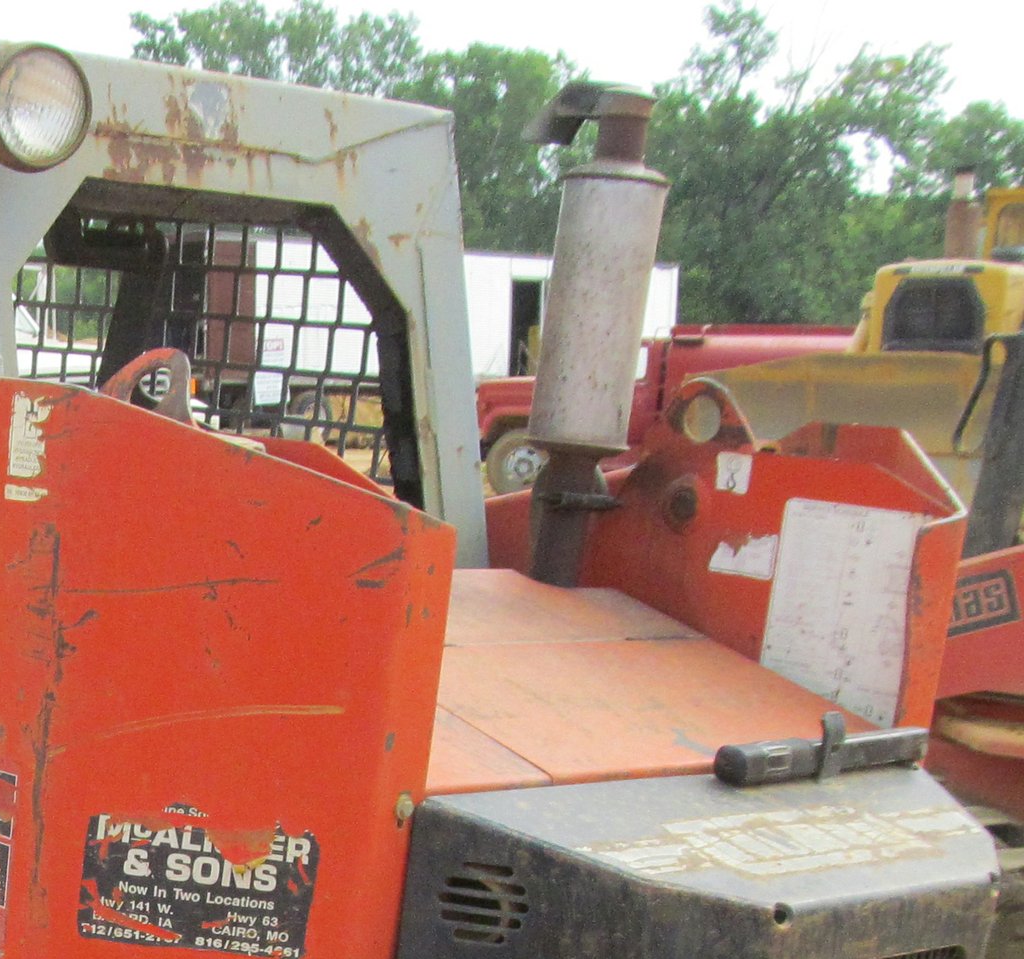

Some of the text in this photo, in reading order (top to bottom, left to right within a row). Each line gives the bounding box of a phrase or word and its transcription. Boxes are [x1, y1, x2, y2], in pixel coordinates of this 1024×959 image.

[123, 848, 277, 893] & SONS
[118, 881, 276, 911] Now In Two Locations
[129, 900, 151, 912] 141
[157, 903, 174, 916] W.
[158, 917, 174, 929] IA
[227, 911, 279, 928] Hwy 63
[266, 930, 290, 943] MO
